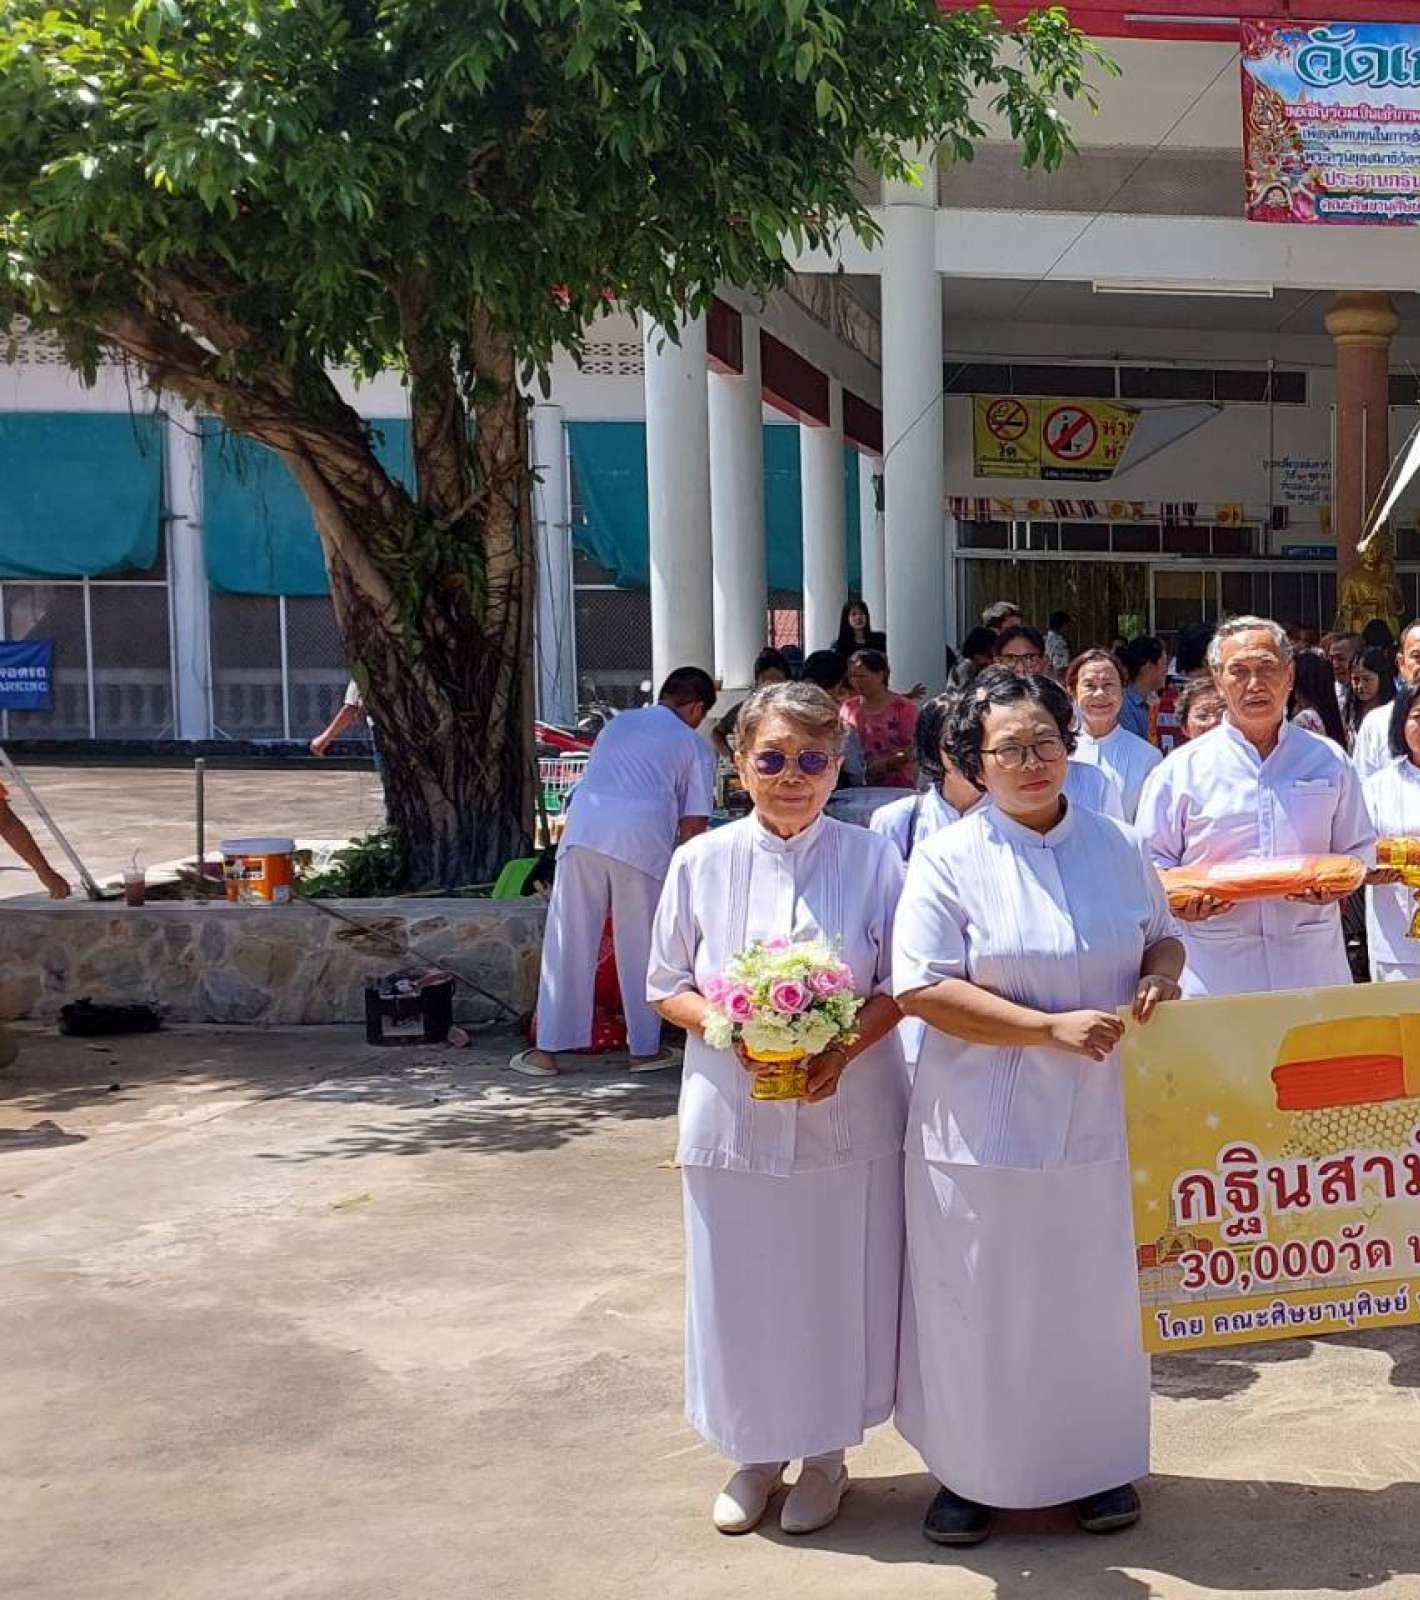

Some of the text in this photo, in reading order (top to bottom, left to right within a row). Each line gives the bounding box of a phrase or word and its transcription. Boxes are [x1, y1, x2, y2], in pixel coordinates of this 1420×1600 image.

[1181, 1225, 1393, 1290] 30,000วัด
[1158, 1313, 1203, 1338] โดย
[1214, 1285, 1408, 1332] คณะศิษยานุศิษย์
